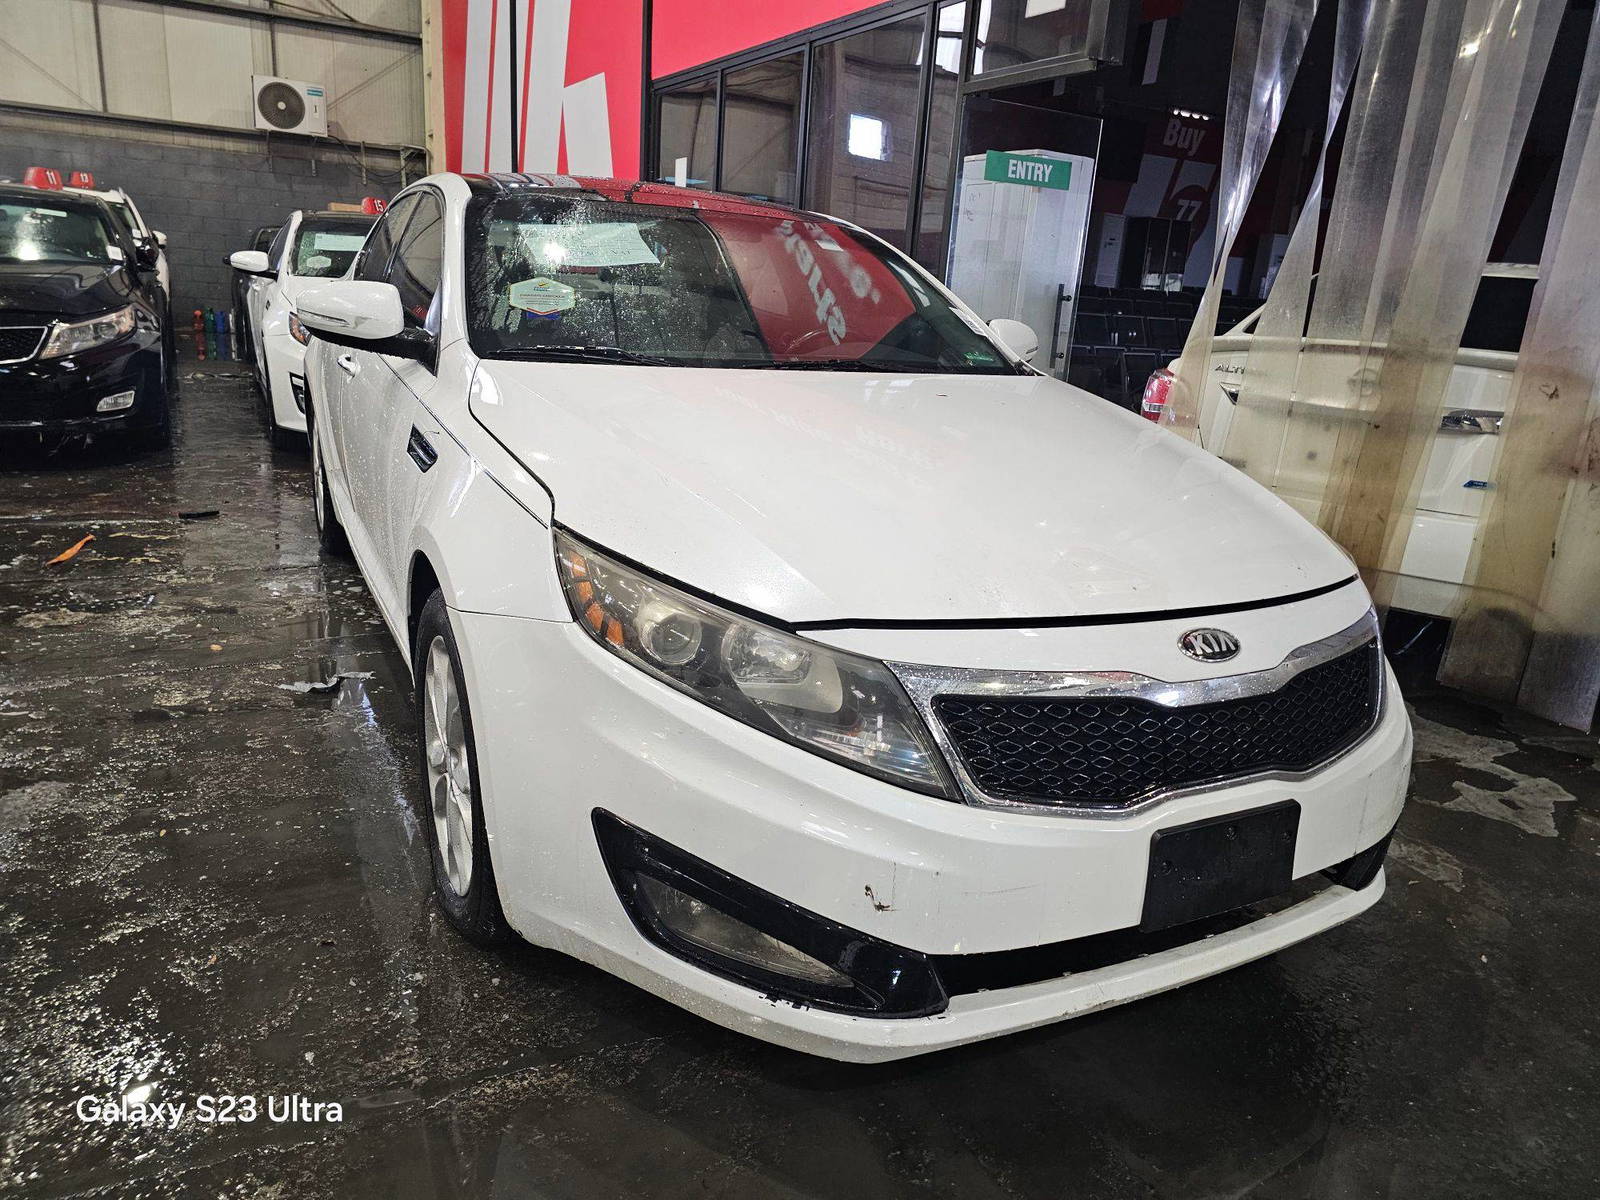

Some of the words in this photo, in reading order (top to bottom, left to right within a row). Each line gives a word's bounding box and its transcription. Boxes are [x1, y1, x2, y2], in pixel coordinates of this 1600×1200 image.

[1163, 119, 1206, 156] Buy
[1008, 160, 1053, 182] ENTRY
[1177, 200, 1203, 222] 77
[1185, 632, 1237, 655] KIA
